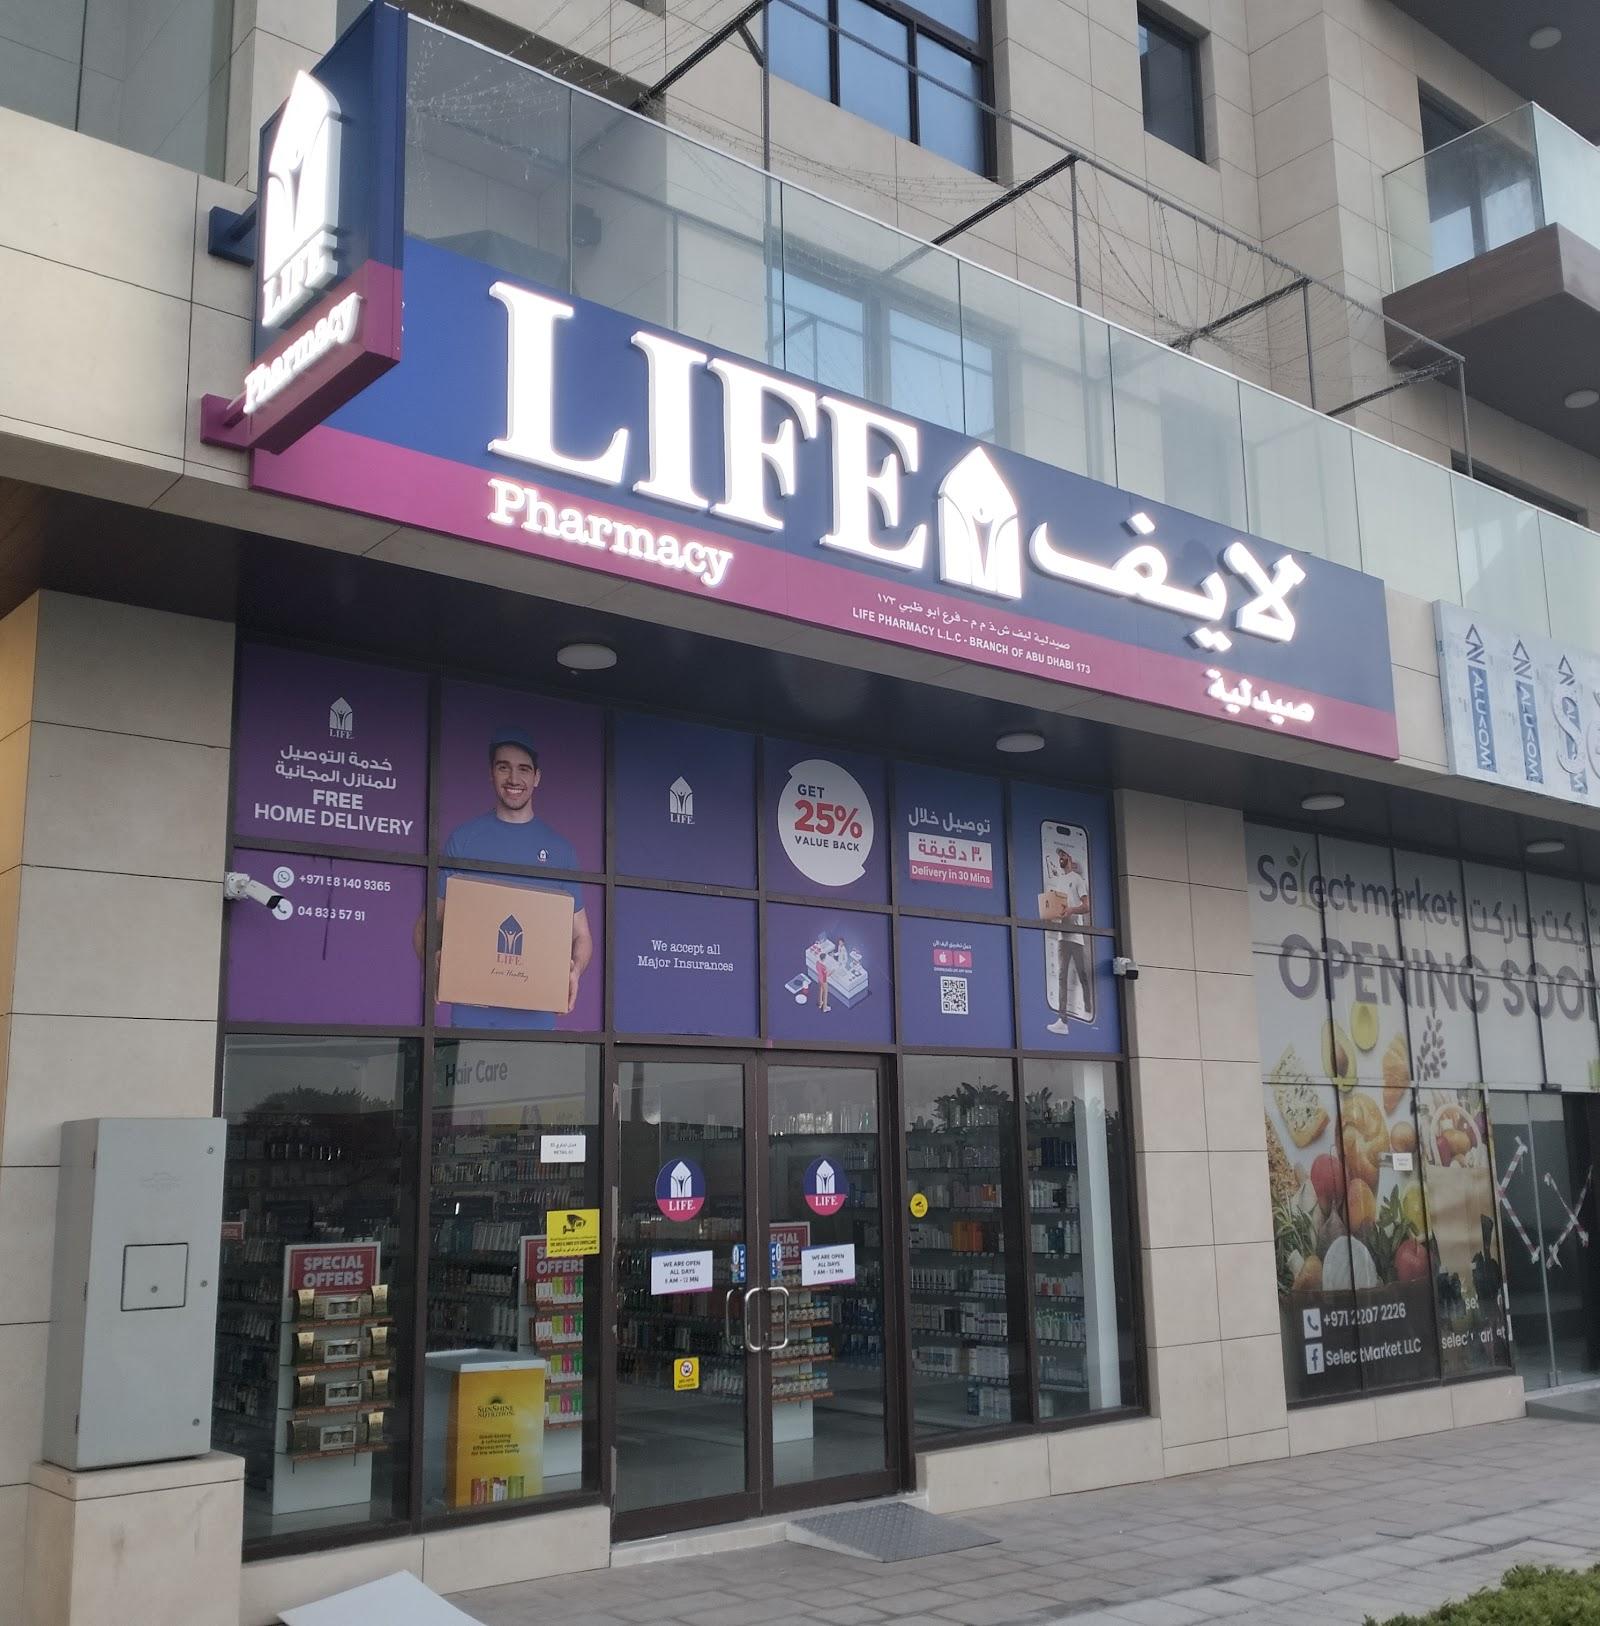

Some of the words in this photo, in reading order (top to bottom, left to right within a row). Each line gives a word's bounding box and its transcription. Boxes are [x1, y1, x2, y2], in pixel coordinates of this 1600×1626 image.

[243, 292, 363, 414] Pharmacy
[487, 281, 928, 570] LIFE
[487, 478, 734, 587] Pharmacy
[1029, 512, 1306, 653] لايف
[878, 592, 896, 605] ١٧٣
[899, 601, 923, 614] ظبي
[852, 607, 876, 622] LIFE
[878, 612, 935, 636] PHARMACY
[937, 628, 962, 643] L.L.C
[969, 636, 1009, 656] BRANCH
[1011, 646, 1024, 658] OF
[1025, 649, 1045, 664] ABU
[1047, 655, 1074, 671] DHABI
[1076, 661, 1091, 674] 173
[1031, 633, 1071, 650] صيدلية
[1205, 669, 1316, 725] صيدلية
[329, 728, 353, 740] LIFE
[280, 745, 345, 765] التوصيل
[348, 751, 393, 771] خدمة
[275, 761, 340, 783] المجانية
[342, 773, 397, 790] للمنازل
[312, 789, 364, 810] FREE
[797, 783, 825, 799] GET
[254, 802, 316, 825] HOME
[320, 810, 414, 836] DELIVERY
[669, 813, 694, 825] LIFE
[794, 799, 863, 839] 25%
[908, 806, 939, 827] خلال
[942, 812, 991, 836] توصيل
[794, 835, 829, 848] VALUE
[832, 840, 860, 852] BACK
[918, 838, 967, 863] دقيقة
[299, 874, 324, 885] +971
[342, 878, 362, 889] 140
[363, 879, 391, 892] 9365
[911, 864, 947, 881] Delivery
[948, 869, 957, 880] in
[959, 870, 969, 880] 30
[970, 872, 990, 884] Mins
[1257, 848, 1356, 912] Select
[1361, 877, 1461, 927] market
[297, 906, 312, 917] 04
[339, 909, 352, 920] 57
[354, 910, 366, 921] 91
[651, 939, 668, 952] We
[669, 942, 704, 956] accept
[706, 943, 721, 955] all
[637, 955, 671, 970] Major
[673, 958, 734, 972] Insurances
[1278, 933, 1491, 1015] OPENING
[445, 1062, 472, 1087] Hair
[475, 1059, 508, 1083] Care
[668, 1199, 696, 1212] LIFE
[815, 1194, 838, 1207] LIFE
[303, 1254, 365, 1271] SPECIAL
[831, 1252, 845, 1260] OPEN
[303, 1271, 364, 1288] OFFERS
[1323, 1309, 1349, 1327] +971
[1380, 1302, 1407, 1321] 2226
[1403, 1337, 1422, 1355] LLC
